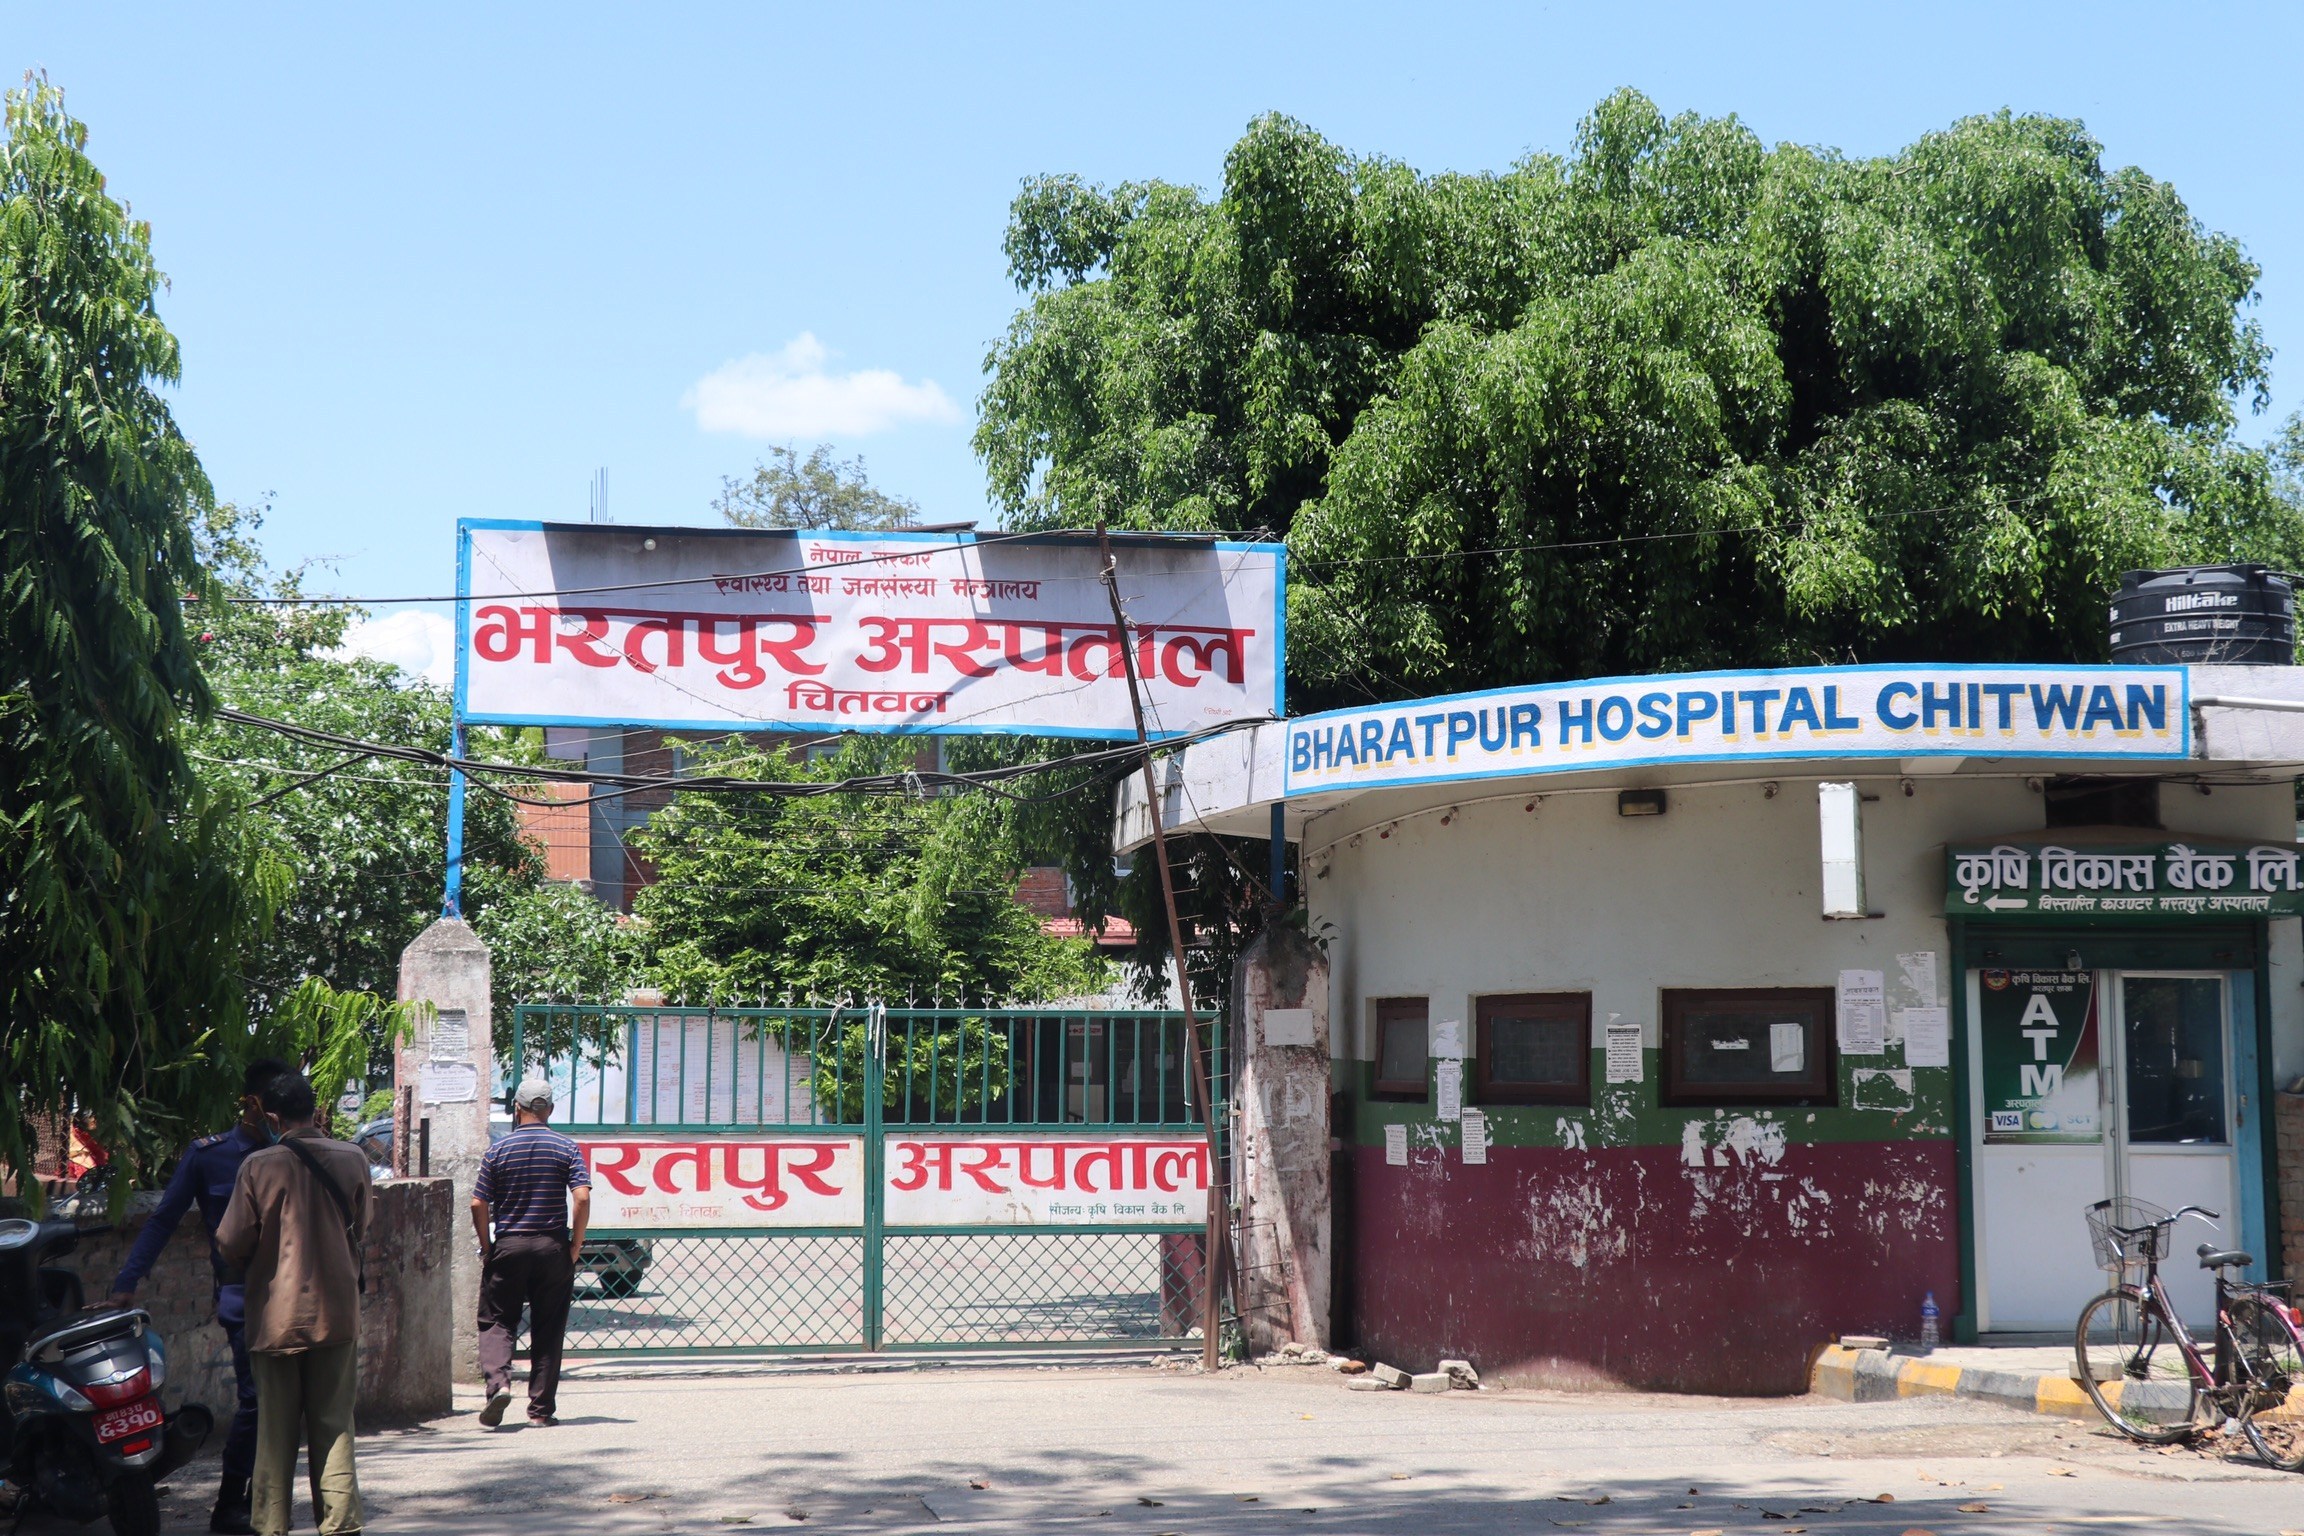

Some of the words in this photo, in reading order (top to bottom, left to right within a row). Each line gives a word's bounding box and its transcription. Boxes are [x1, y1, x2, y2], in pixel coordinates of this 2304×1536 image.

[809, 542, 862, 567] नेपाल
[871, 551, 934, 569] सरकार
[712, 573, 790, 596] स्वास्थ्य
[797, 575, 832, 595] तथा
[841, 573, 938, 600] जनसंख्या
[950, 576, 1041, 601] मन्त्रालय
[2165, 591, 2238, 613] Hilltake
[2164, 621, 2187, 634] EXTRA
[2188, 619, 2211, 631] HEAVY
[2212, 618, 2240, 630] WEIGHT
[473, 604, 832, 690] भरतपुर
[854, 615, 1255, 688] अस्पताल
[783, 679, 953, 715] चितवन
[1292, 703, 1541, 774] BHARATPUR
[1557, 684, 1860, 747] HOSPITAL
[1876, 681, 2168, 736] CHITWAN
[1955, 846, 2031, 904] कृषि
[2038, 846, 2156, 892] विकास
[2165, 843, 2236, 890] बैंक
[2246, 845, 2304, 893] लि.
[2159, 897, 2206, 914] भरतपुर
[2208, 896, 2271, 913] अस्पताल
[2019, 994, 2064, 1097] ATM
[1995, 1115, 2020, 1126] VISA
[890, 1141, 1212, 1194] अस्पताल
[1087, 1202, 1107, 1219] कृषि
[1113, 1202, 1145, 1216] विकास
